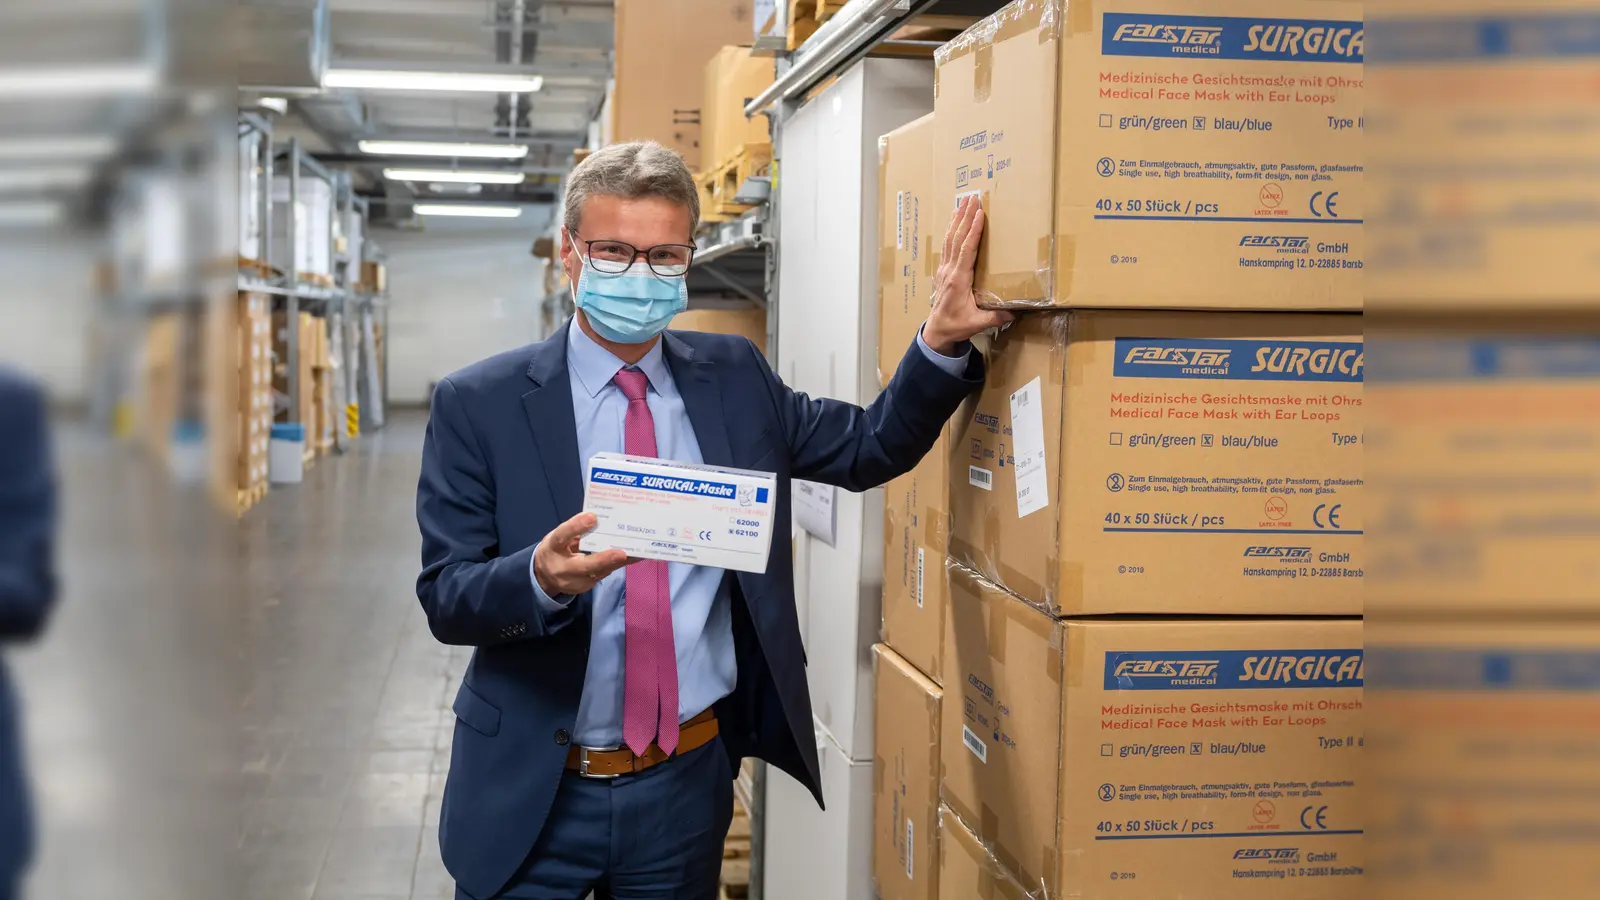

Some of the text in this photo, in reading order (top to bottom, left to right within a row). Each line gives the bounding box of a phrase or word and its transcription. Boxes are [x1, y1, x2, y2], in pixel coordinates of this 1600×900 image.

[1172, 45, 1220, 54] medical
[1099, 73, 1188, 84] Medizinische
[1193, 74, 1295, 86] Gesichtsmaske
[1300, 76, 1321, 87] mit
[1099, 88, 1335, 104] Medical Face Mask with Ear Loops
[1119, 115, 1187, 129] grün/green
[1214, 118, 1272, 131] blau/blue
[1328, 117, 1353, 128] Type
[1140, 160, 1201, 170] Einmalgebrauch,
[1205, 162, 1256, 171] atmungsaktiv,
[1260, 163, 1277, 172] gute
[1281, 163, 1317, 172] Passform,
[1119, 169, 1142, 178] Single
[1164, 170, 1180, 178] high
[1184, 170, 1232, 179] breathability,
[1265, 172, 1292, 180] design,
[1096, 200, 1111, 211] 40
[1115, 203, 1122, 211] x
[1126, 200, 1141, 211] 50
[1145, 200, 1181, 212] Stück
[1195, 202, 1218, 216] pcs
[1317, 243, 1348, 253] GmbH
[1239, 258, 1294, 269] Hanskampring
[1309, 259, 1340, 268] D-22885
[1342, 260, 1363, 268] Barsb
[1110, 393, 1362, 406] Medizinische Gesichtsmaske mit Ohrs
[1110, 408, 1340, 423] Medical Face Mask with Ear Loops
[1129, 433, 1357, 448] grün/green blau/blue Type
[641, 476, 734, 496] SURGICAL-Maske
[1148, 476, 1208, 485] Einmalgebrauch,
[1212, 477, 1263, 485] atmungsaktiv,
[1266, 478, 1282, 486] gute
[1286, 478, 1320, 486] Passform,
[1128, 485, 1151, 493] Single
[1191, 485, 1238, 494] breathability,
[1270, 486, 1296, 494] design,
[736, 519, 760, 528] 62000
[1105, 513, 1120, 524] 40
[1124, 516, 1131, 524] x
[1135, 513, 1150, 524] 50
[1154, 513, 1188, 525] Stück
[1201, 515, 1224, 527] pcs
[1319, 553, 1349, 562] GmbH
[1243, 568, 1296, 578] Hanskampring
[1311, 568, 1341, 577] D-22885
[1102, 700, 1362, 715] Medizinische Gesichtsmaske mit Ohrsch
[1102, 716, 1326, 729] Medical Face Mask with Ear Loops
[1120, 743, 1185, 758] grün/green
[1210, 742, 1265, 755] blau/blue
[1319, 737, 1342, 749] Type
[1139, 783, 1198, 792] Einmalgebrauch,
[1254, 782, 1270, 790] gute
[1181, 791, 1227, 799] breathability,
[1096, 821, 1111, 832] 40
[1126, 820, 1140, 831] 50
[1144, 820, 1178, 831] Stück
[1192, 820, 1214, 832] pcs
[1307, 853, 1337, 862] GmbH
[1233, 869, 1284, 879] Hanskampring
